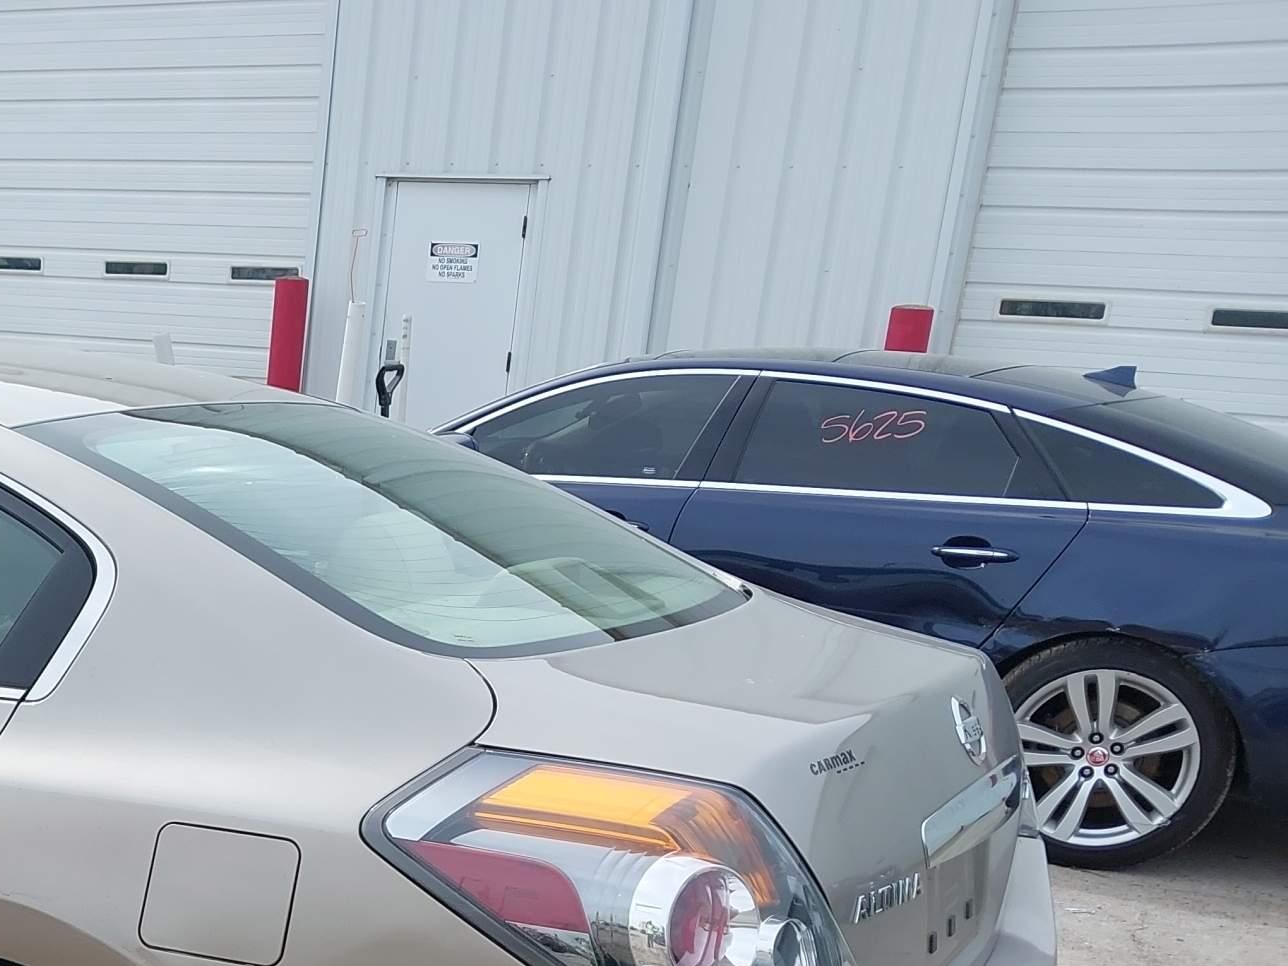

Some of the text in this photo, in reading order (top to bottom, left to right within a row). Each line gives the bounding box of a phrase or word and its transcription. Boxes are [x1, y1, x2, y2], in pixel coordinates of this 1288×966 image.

[437, 246, 472, 256] DANGER
[454, 264, 472, 272] FLAMES
[821, 409, 927, 443] 5625
